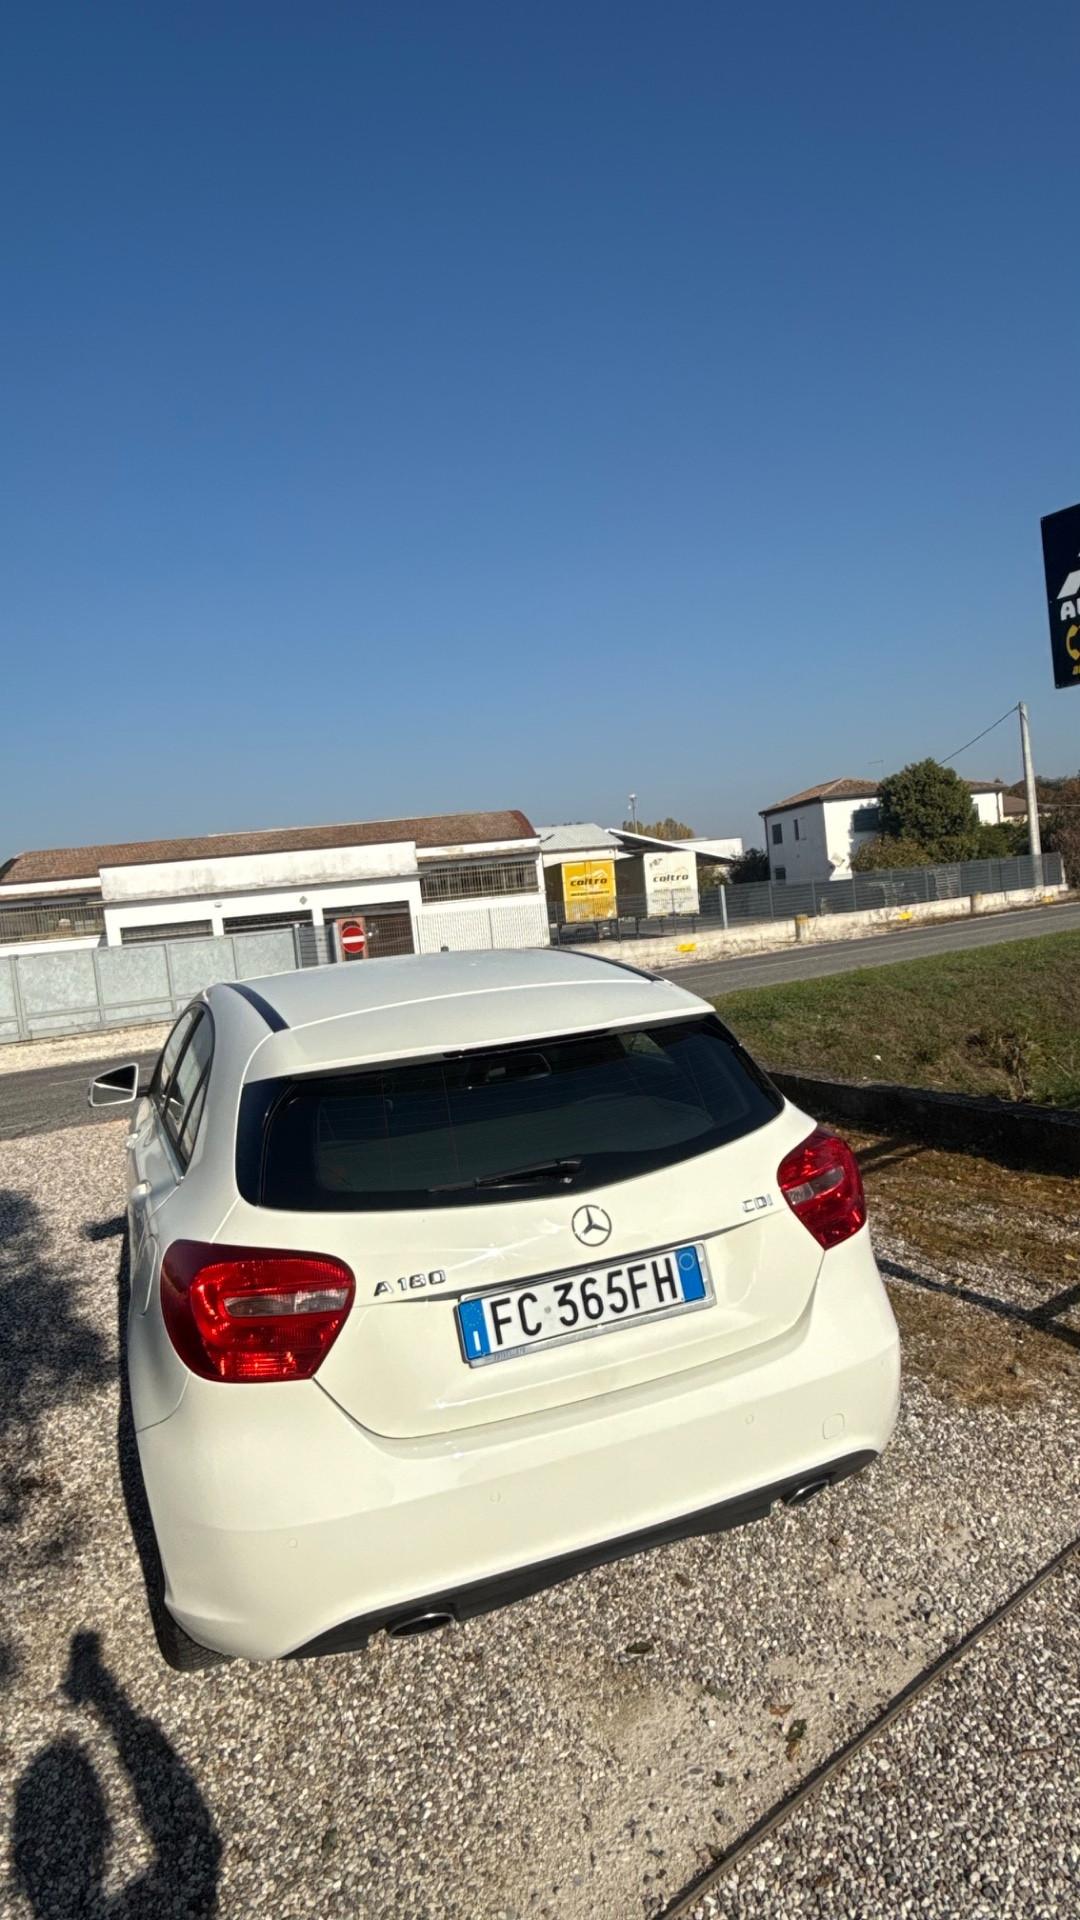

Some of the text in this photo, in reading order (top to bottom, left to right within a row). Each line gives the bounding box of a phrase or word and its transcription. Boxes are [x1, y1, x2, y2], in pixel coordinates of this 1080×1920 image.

[1060, 598, 1080, 621] A
[570, 877, 608, 887] coltro
[742, 1193, 773, 1213] CDI
[397, 1269, 446, 1291] 180
[489, 1256, 680, 1346] FC 365FH
